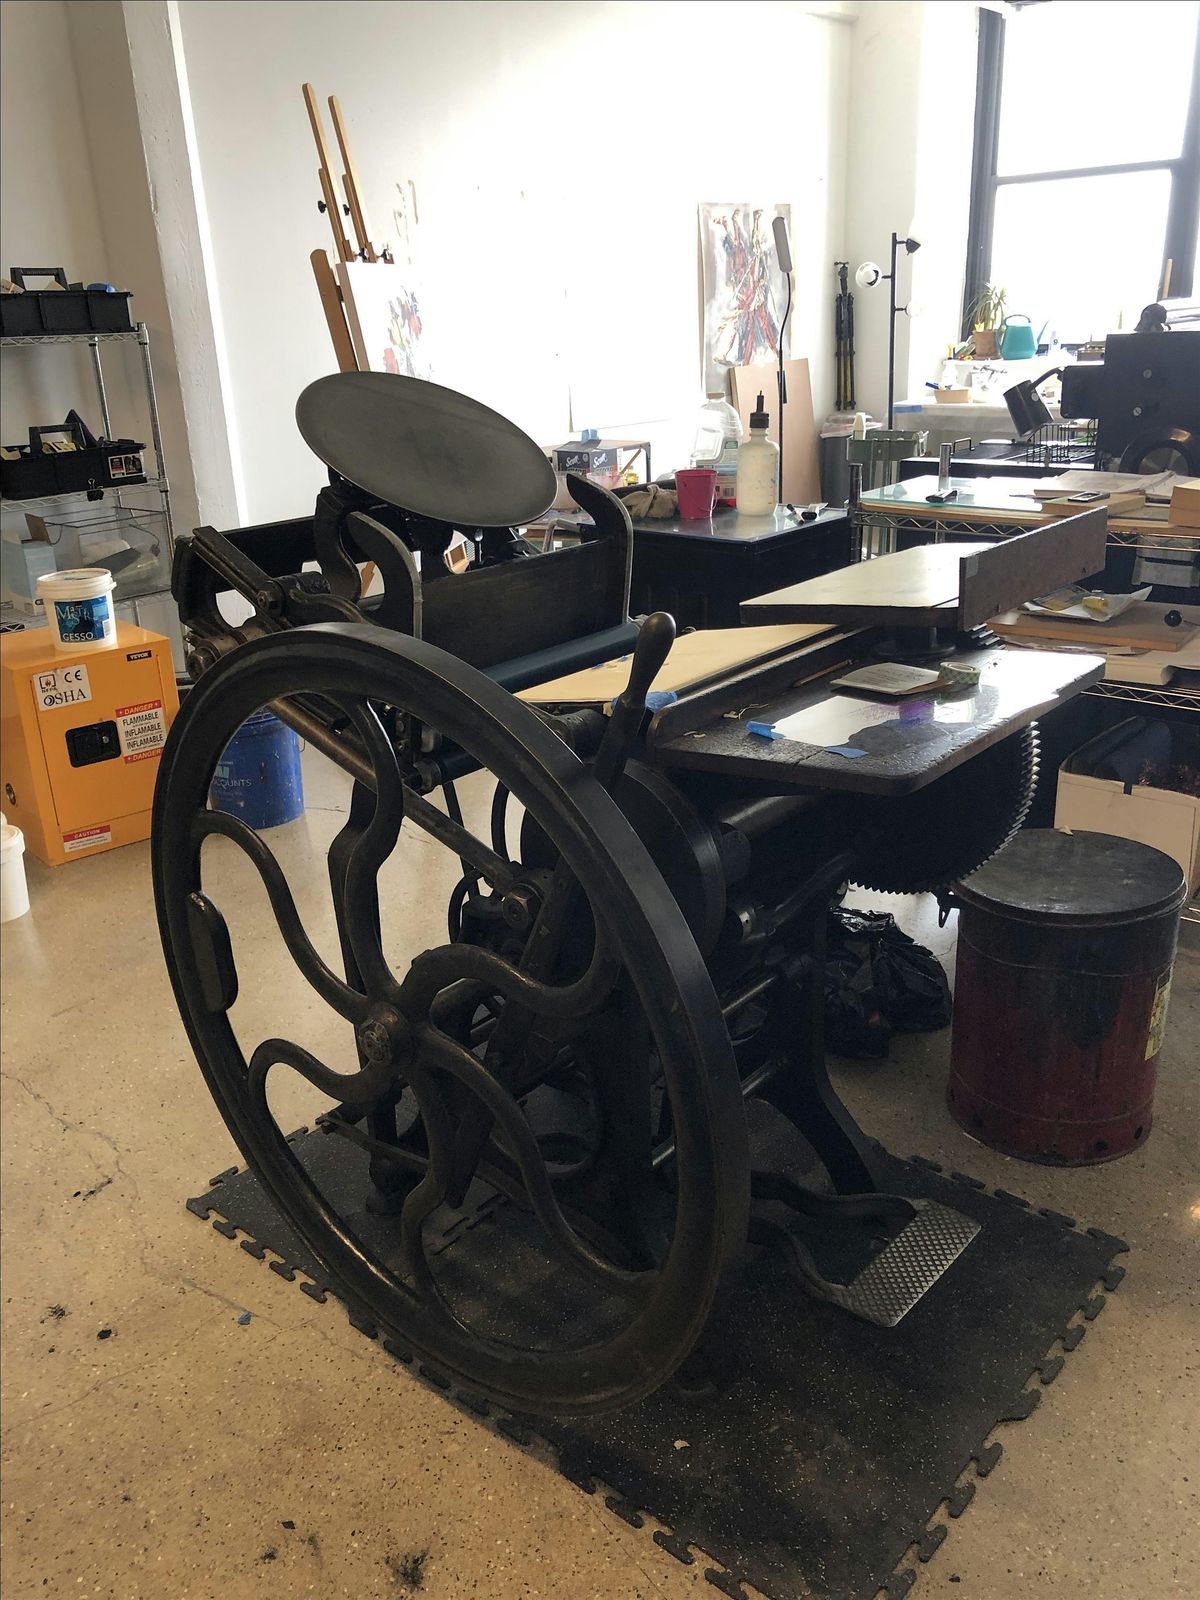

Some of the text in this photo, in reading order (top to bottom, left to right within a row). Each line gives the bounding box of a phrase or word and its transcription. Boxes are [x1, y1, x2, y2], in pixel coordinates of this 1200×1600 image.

[62, 632, 94, 641] GESSO
[43, 688, 87, 706] OSHA
[124, 702, 154, 715] DANGER
[122, 711, 159, 726] FLAMMABLE
[124, 722, 162, 738] INFLAMABLE
[127, 733, 163, 750] INFLAMABLE
[132, 749, 163, 761] DANGER
[74, 829, 101, 839] CAUTION
